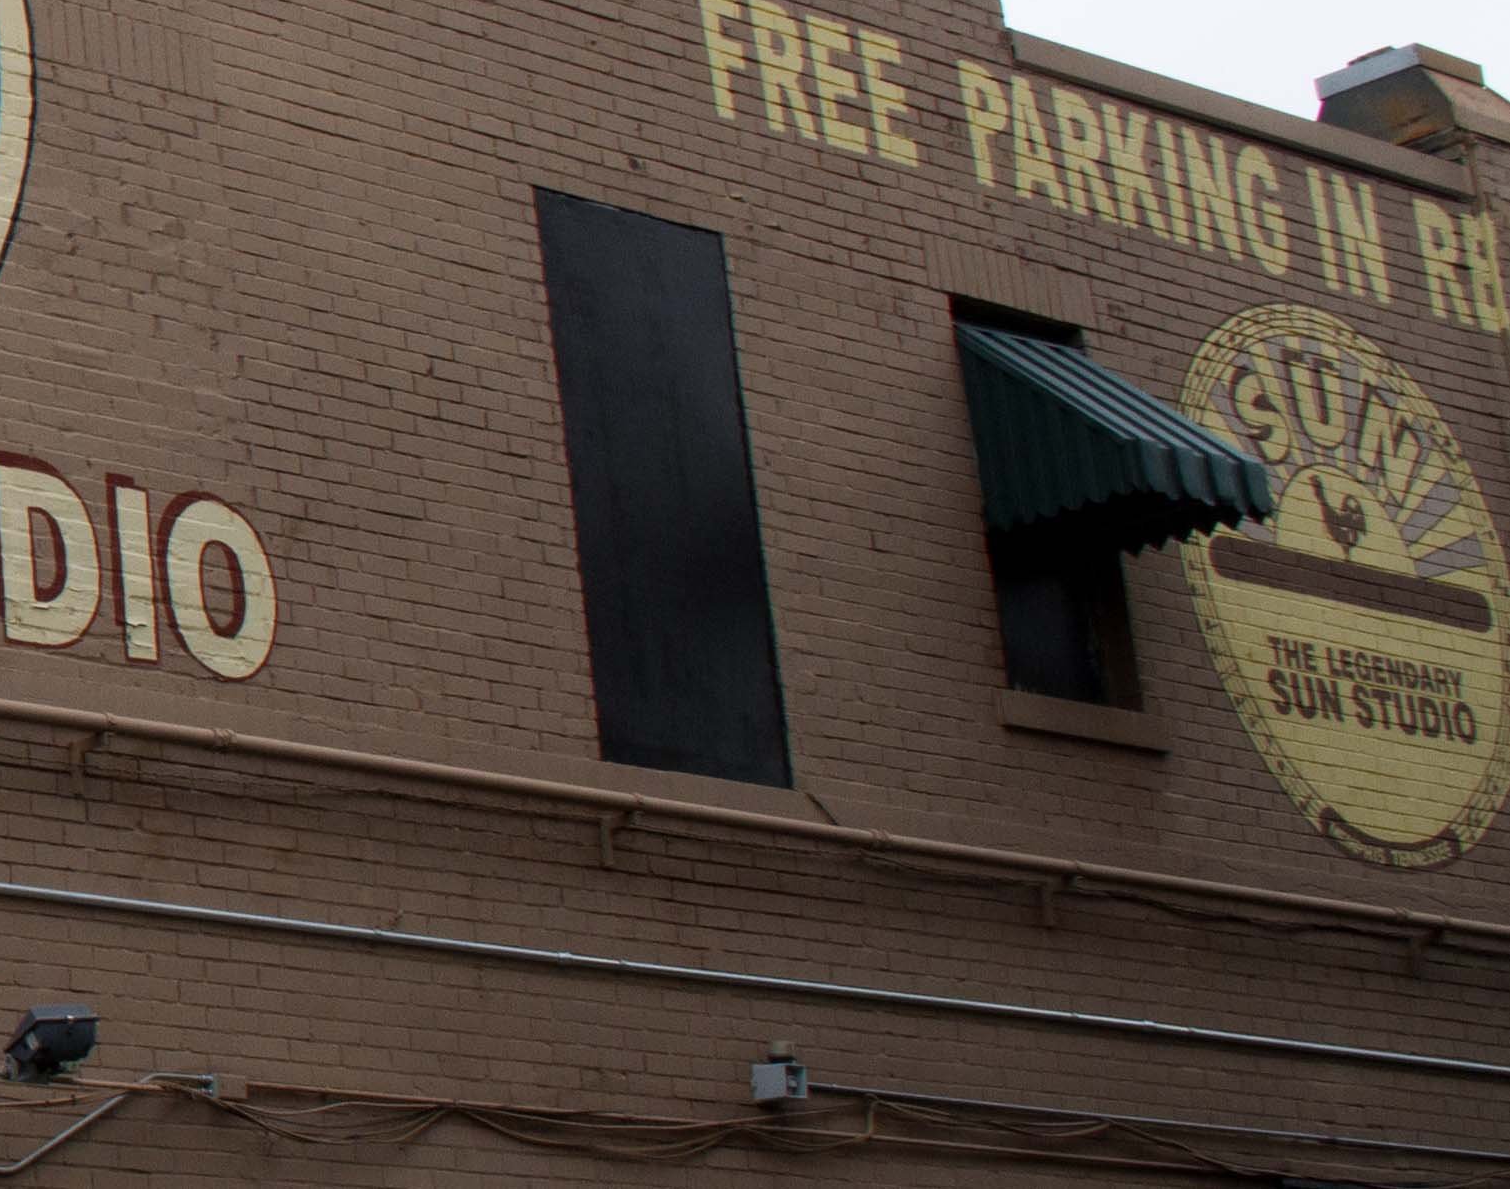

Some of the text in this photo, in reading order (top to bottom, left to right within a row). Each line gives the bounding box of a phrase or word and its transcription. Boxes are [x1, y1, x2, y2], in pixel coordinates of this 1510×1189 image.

[957, 58, 1291, 277] PARKING
[1307, 167, 1392, 304] IN
[1229, 348, 1422, 509] SUN
[1267, 635, 1463, 699] THE LEGENDARY
[1267, 668, 1477, 745] SUN STUDIO
